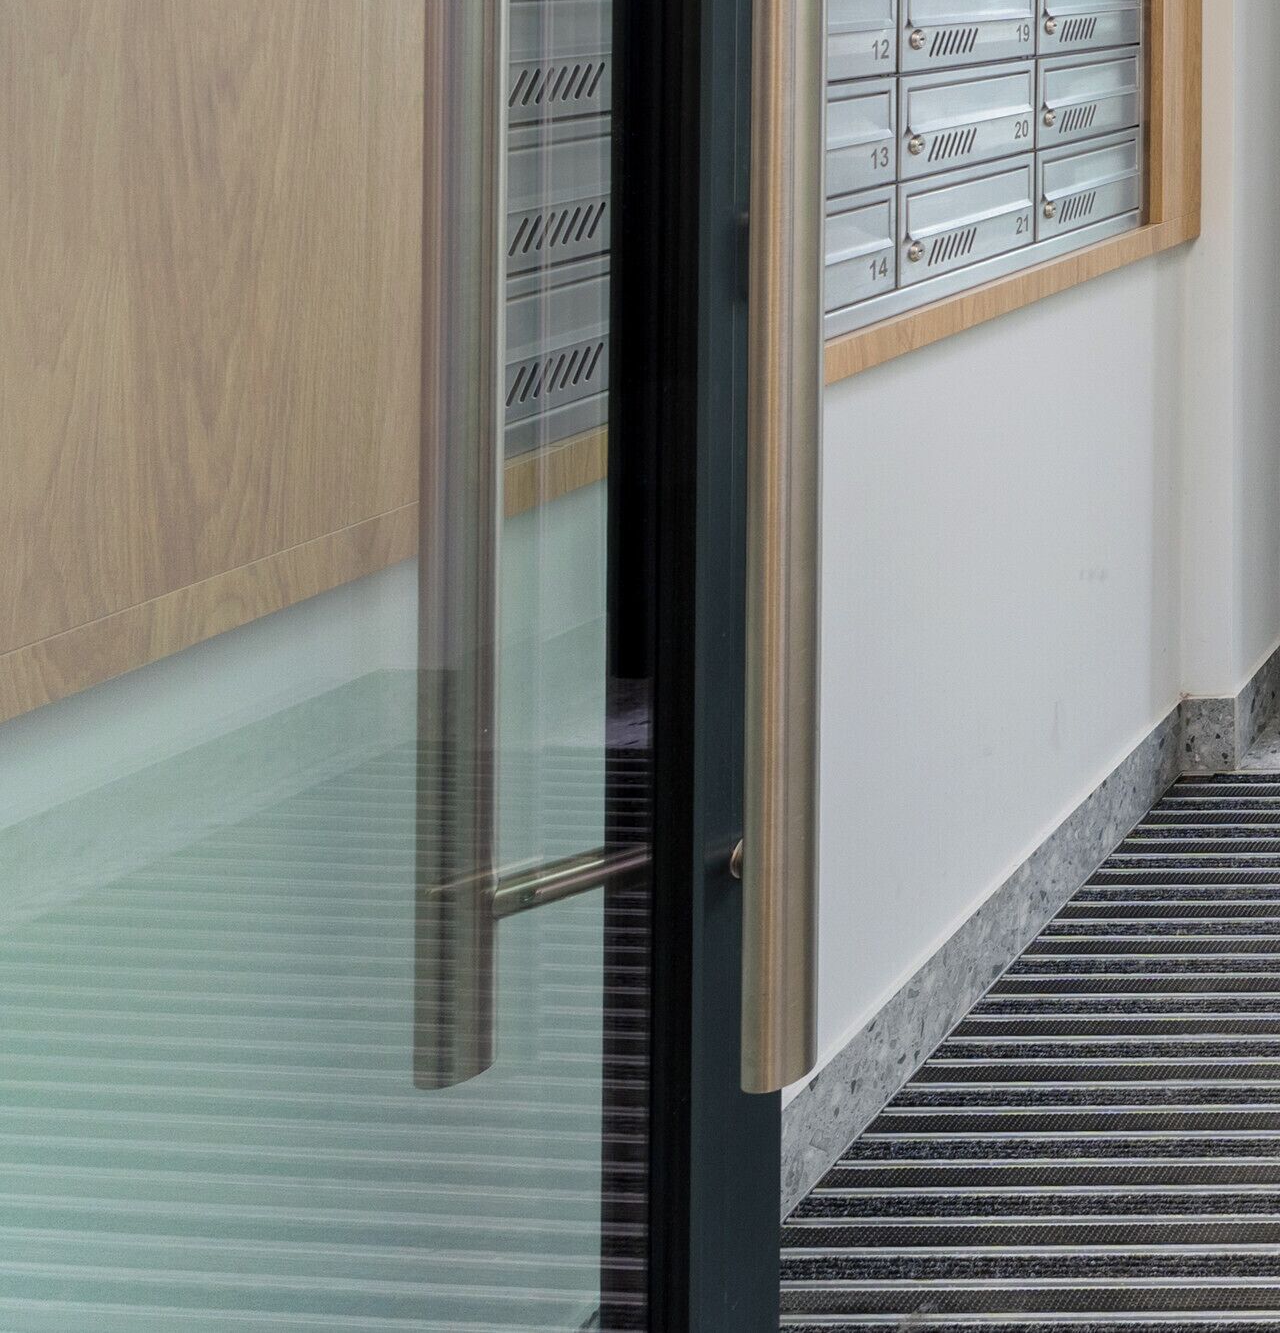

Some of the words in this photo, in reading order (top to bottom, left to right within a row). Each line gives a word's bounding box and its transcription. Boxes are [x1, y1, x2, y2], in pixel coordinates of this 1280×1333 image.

[1016, 24, 1030, 43] 19
[871, 39, 890, 60] 12
[1014, 120, 1029, 141] 20
[871, 147, 889, 170] 13
[1016, 215, 1029, 236] 21
[869, 257, 888, 281] 14
